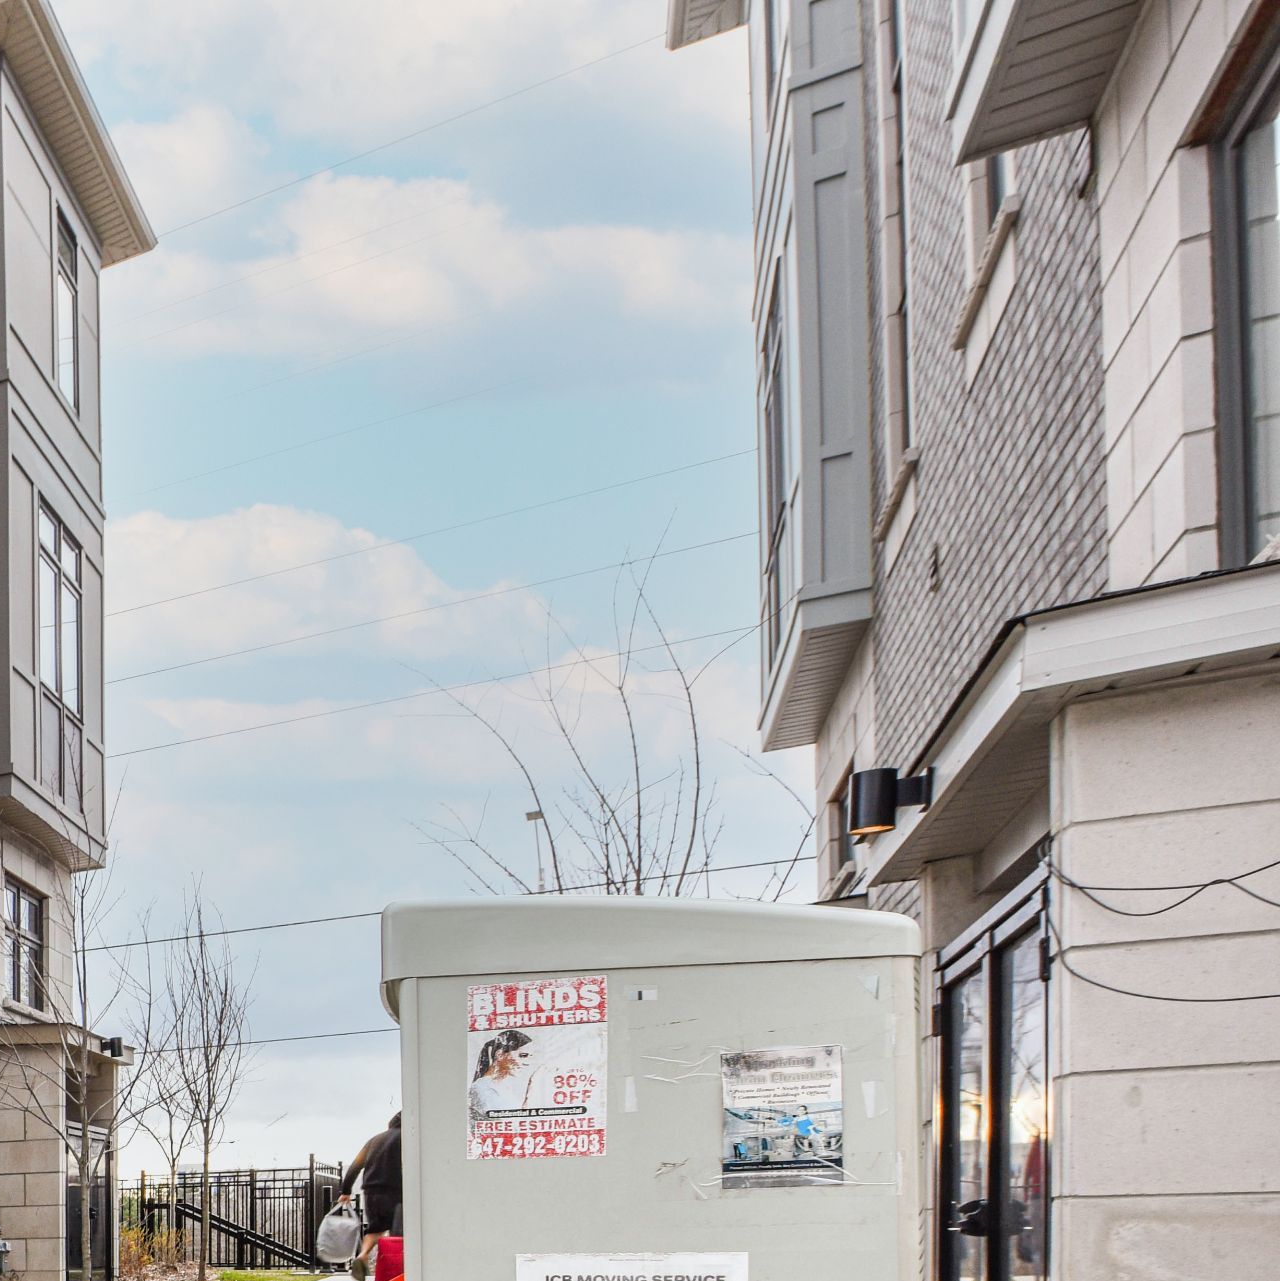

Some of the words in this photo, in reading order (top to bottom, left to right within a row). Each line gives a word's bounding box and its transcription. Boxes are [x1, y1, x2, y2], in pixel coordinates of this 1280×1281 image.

[473, 985, 601, 1014] BLINDS
[496, 1009, 600, 1028] SHUTTERS
[553, 1090, 592, 1104] OFF
[489, 1110, 529, 1118] Residential
[538, 1107, 582, 1116] Commercial
[476, 1121, 512, 1132] FREE
[520, 1118, 595, 1131] ESTIMATE
